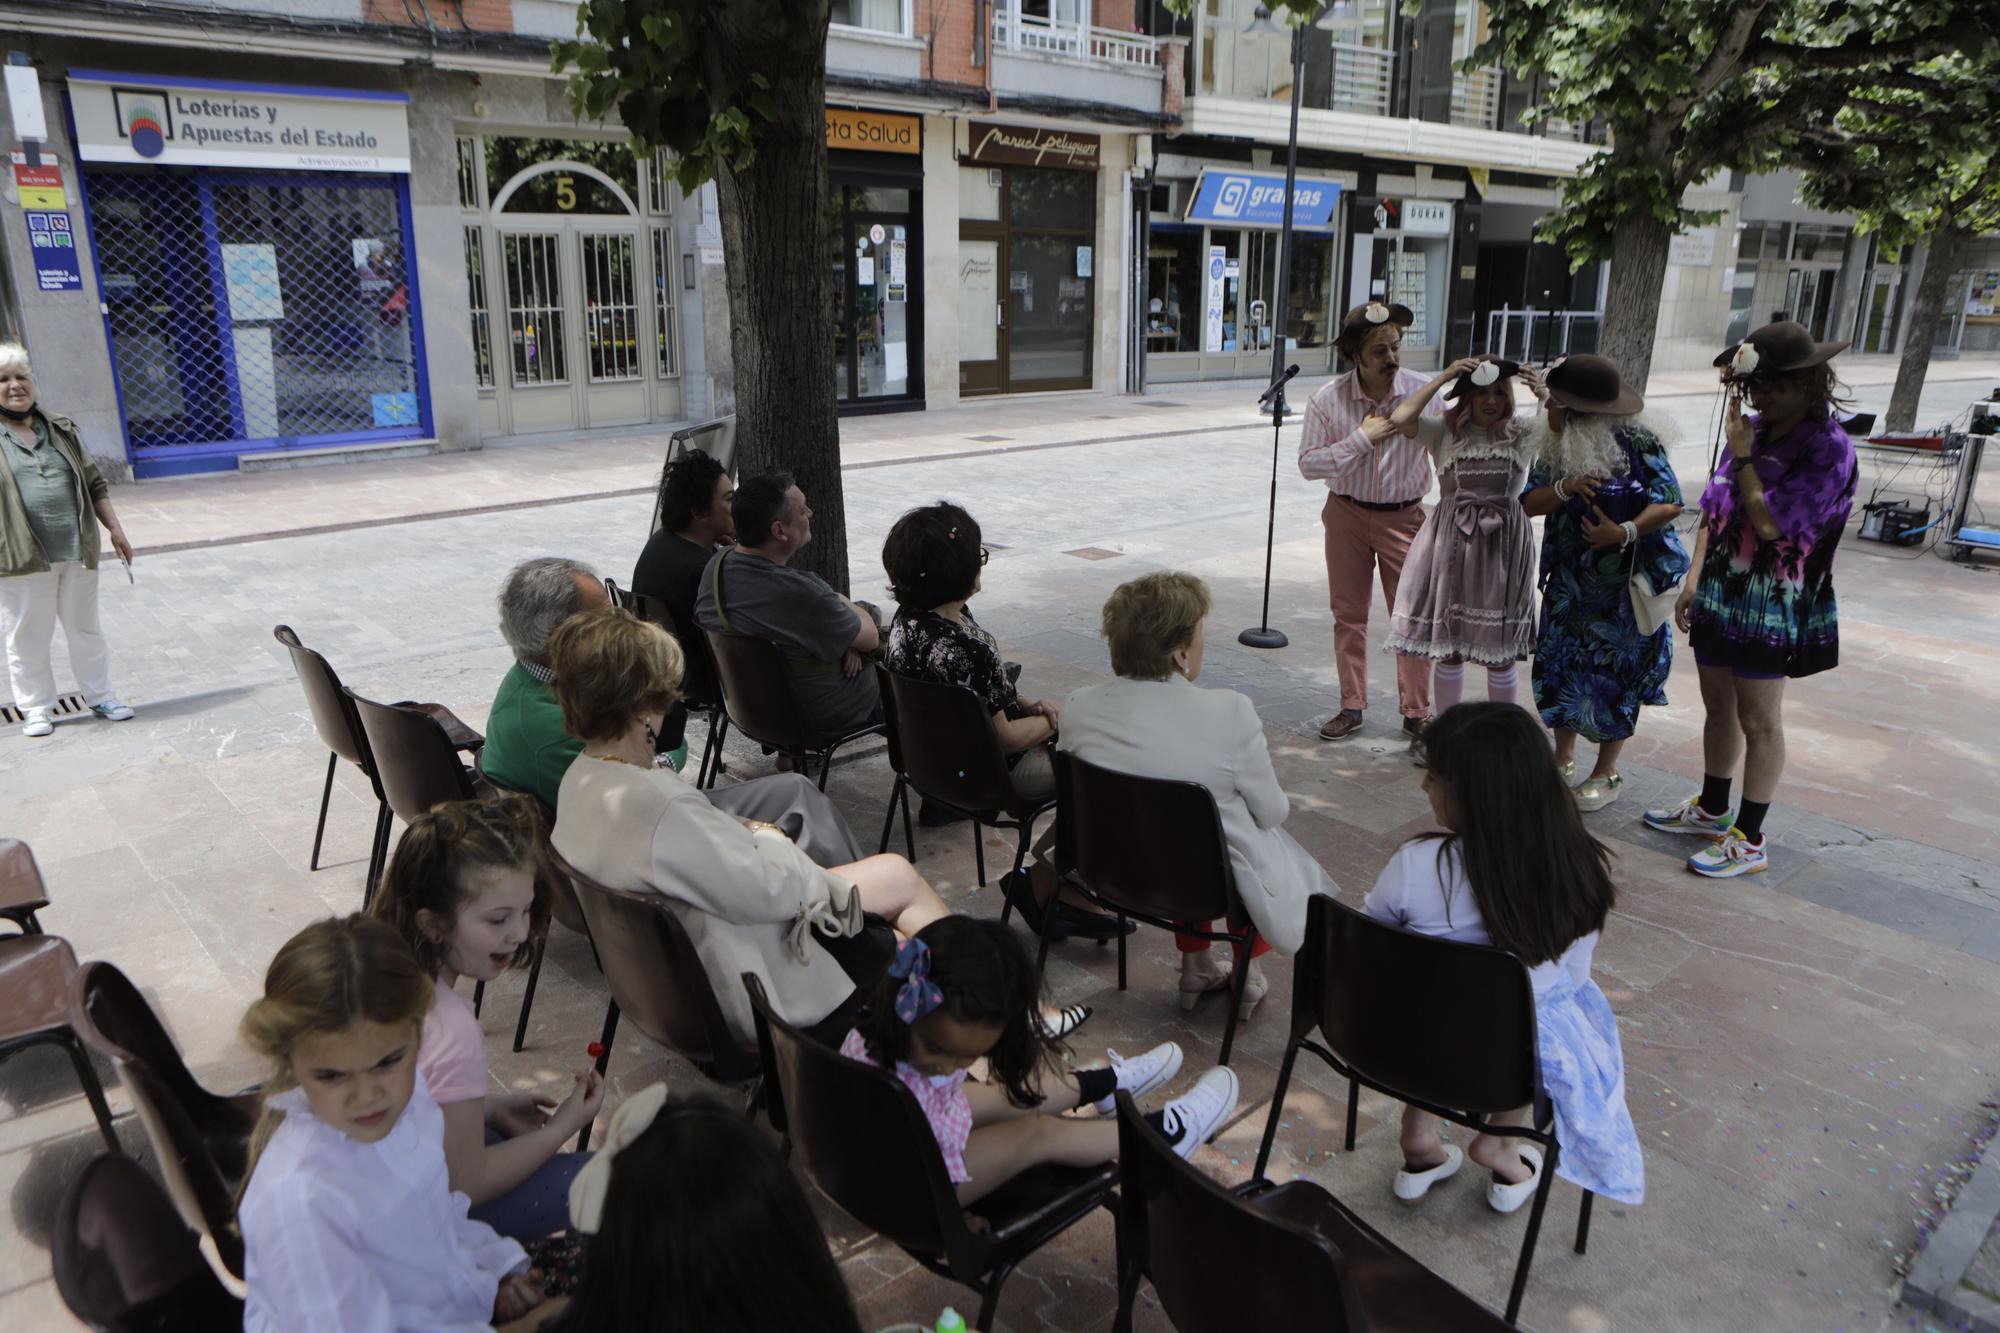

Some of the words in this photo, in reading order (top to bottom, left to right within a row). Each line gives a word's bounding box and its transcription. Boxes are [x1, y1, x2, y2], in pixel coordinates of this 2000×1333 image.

[176, 96, 260, 120] Loterías
[266, 105, 277, 125] y
[180, 122, 273, 146] Apuestas
[280, 125, 308, 147] del
[315, 129, 378, 149] Estado
[857, 120, 911, 144] Salud
[556, 176, 577, 210] 5
[1411, 206, 1445, 220] DURÁN
